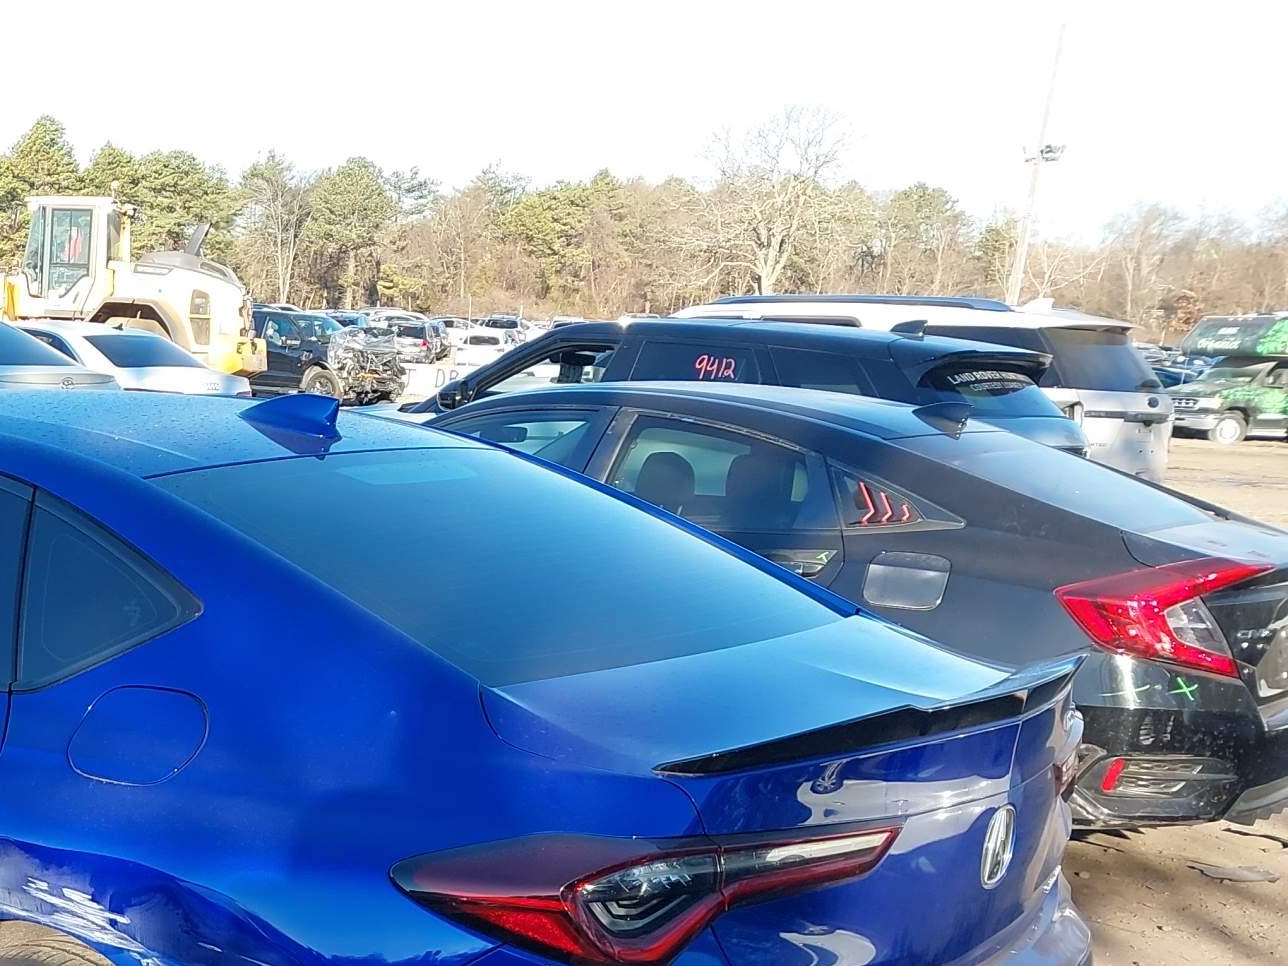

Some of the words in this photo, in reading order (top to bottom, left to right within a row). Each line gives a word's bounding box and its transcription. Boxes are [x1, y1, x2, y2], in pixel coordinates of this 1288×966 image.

[695, 354, 736, 380] 9412
[947, 372, 974, 385] LAND
[974, 371, 1001, 381] ROVER
